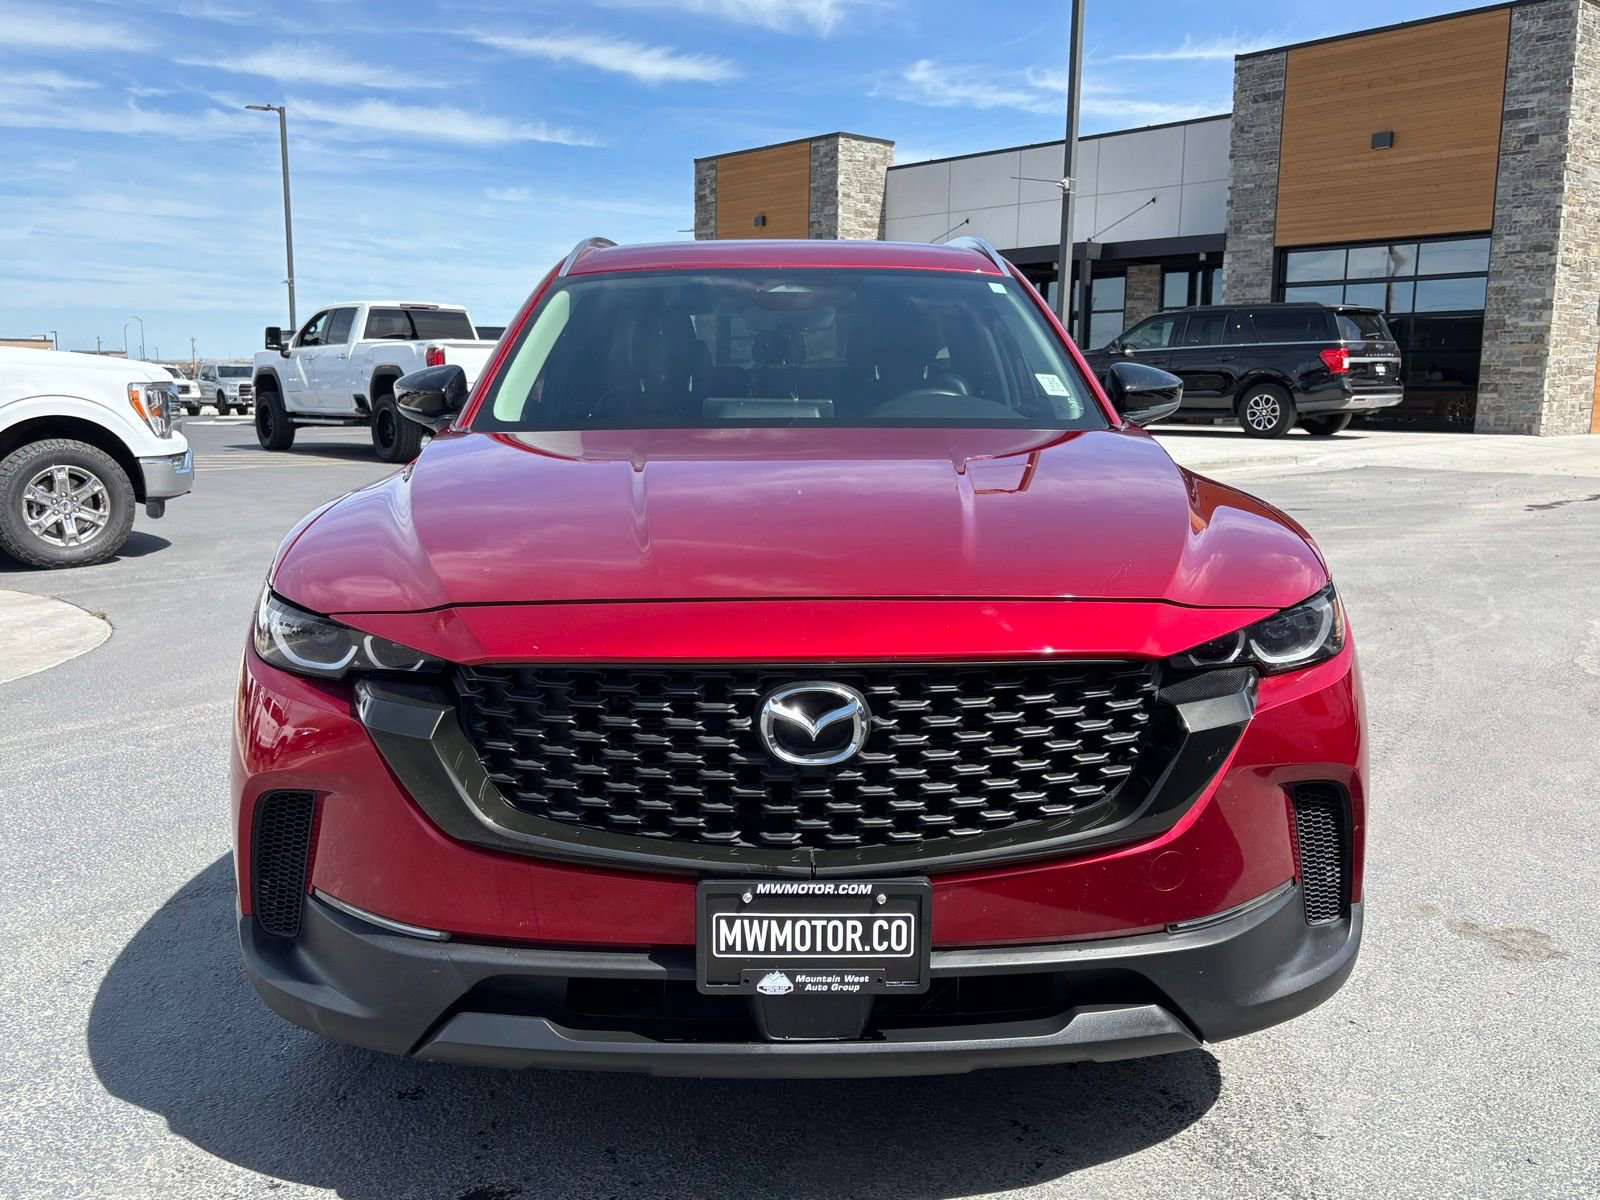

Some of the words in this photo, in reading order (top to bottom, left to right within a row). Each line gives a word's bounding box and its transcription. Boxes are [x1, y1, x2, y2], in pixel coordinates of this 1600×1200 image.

[756, 883, 873, 895] MWMOTOR.COM
[719, 919, 908, 952] MWMOTOR.CO
[795, 974, 841, 983] Mountain
[844, 974, 870, 983] West
[804, 983, 829, 991] Auto
[831, 983, 860, 993] Group
